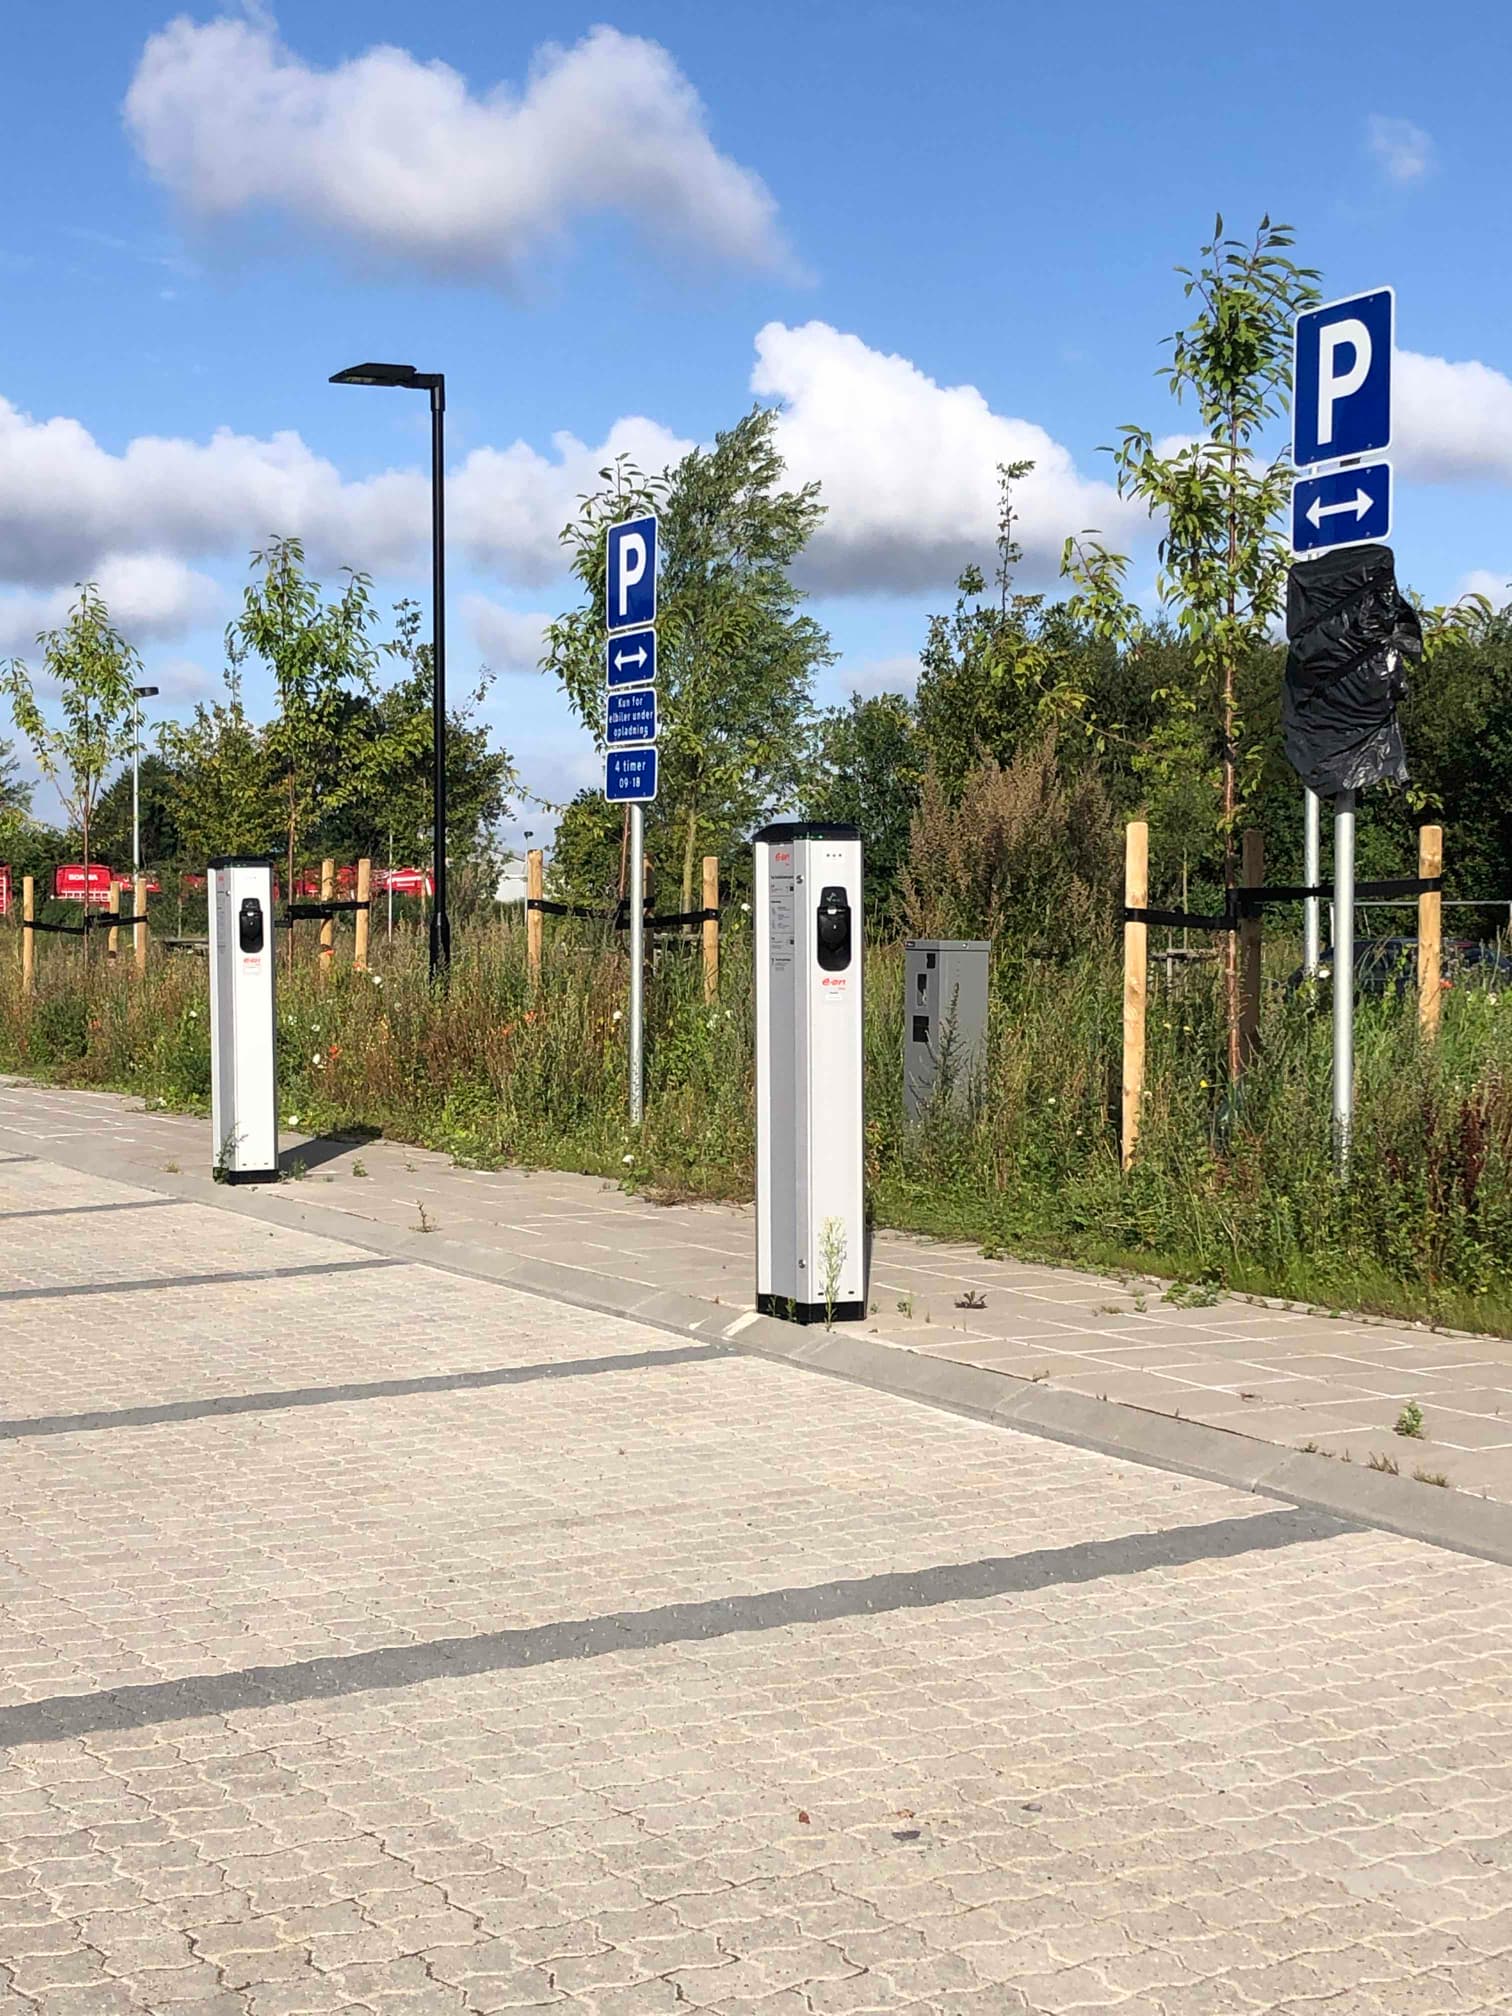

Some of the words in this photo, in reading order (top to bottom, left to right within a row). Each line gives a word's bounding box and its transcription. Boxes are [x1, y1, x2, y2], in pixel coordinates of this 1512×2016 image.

[1317, 318, 1372, 446] P
[619, 533, 646, 616] P
[618, 697, 630, 708] Kun
[632, 696, 643, 706] for
[609, 711, 631, 723] elbiler
[632, 709, 653, 720] under
[613, 725, 648, 738] opladning
[615, 760, 620, 772] 4
[623, 760, 646, 772] timer
